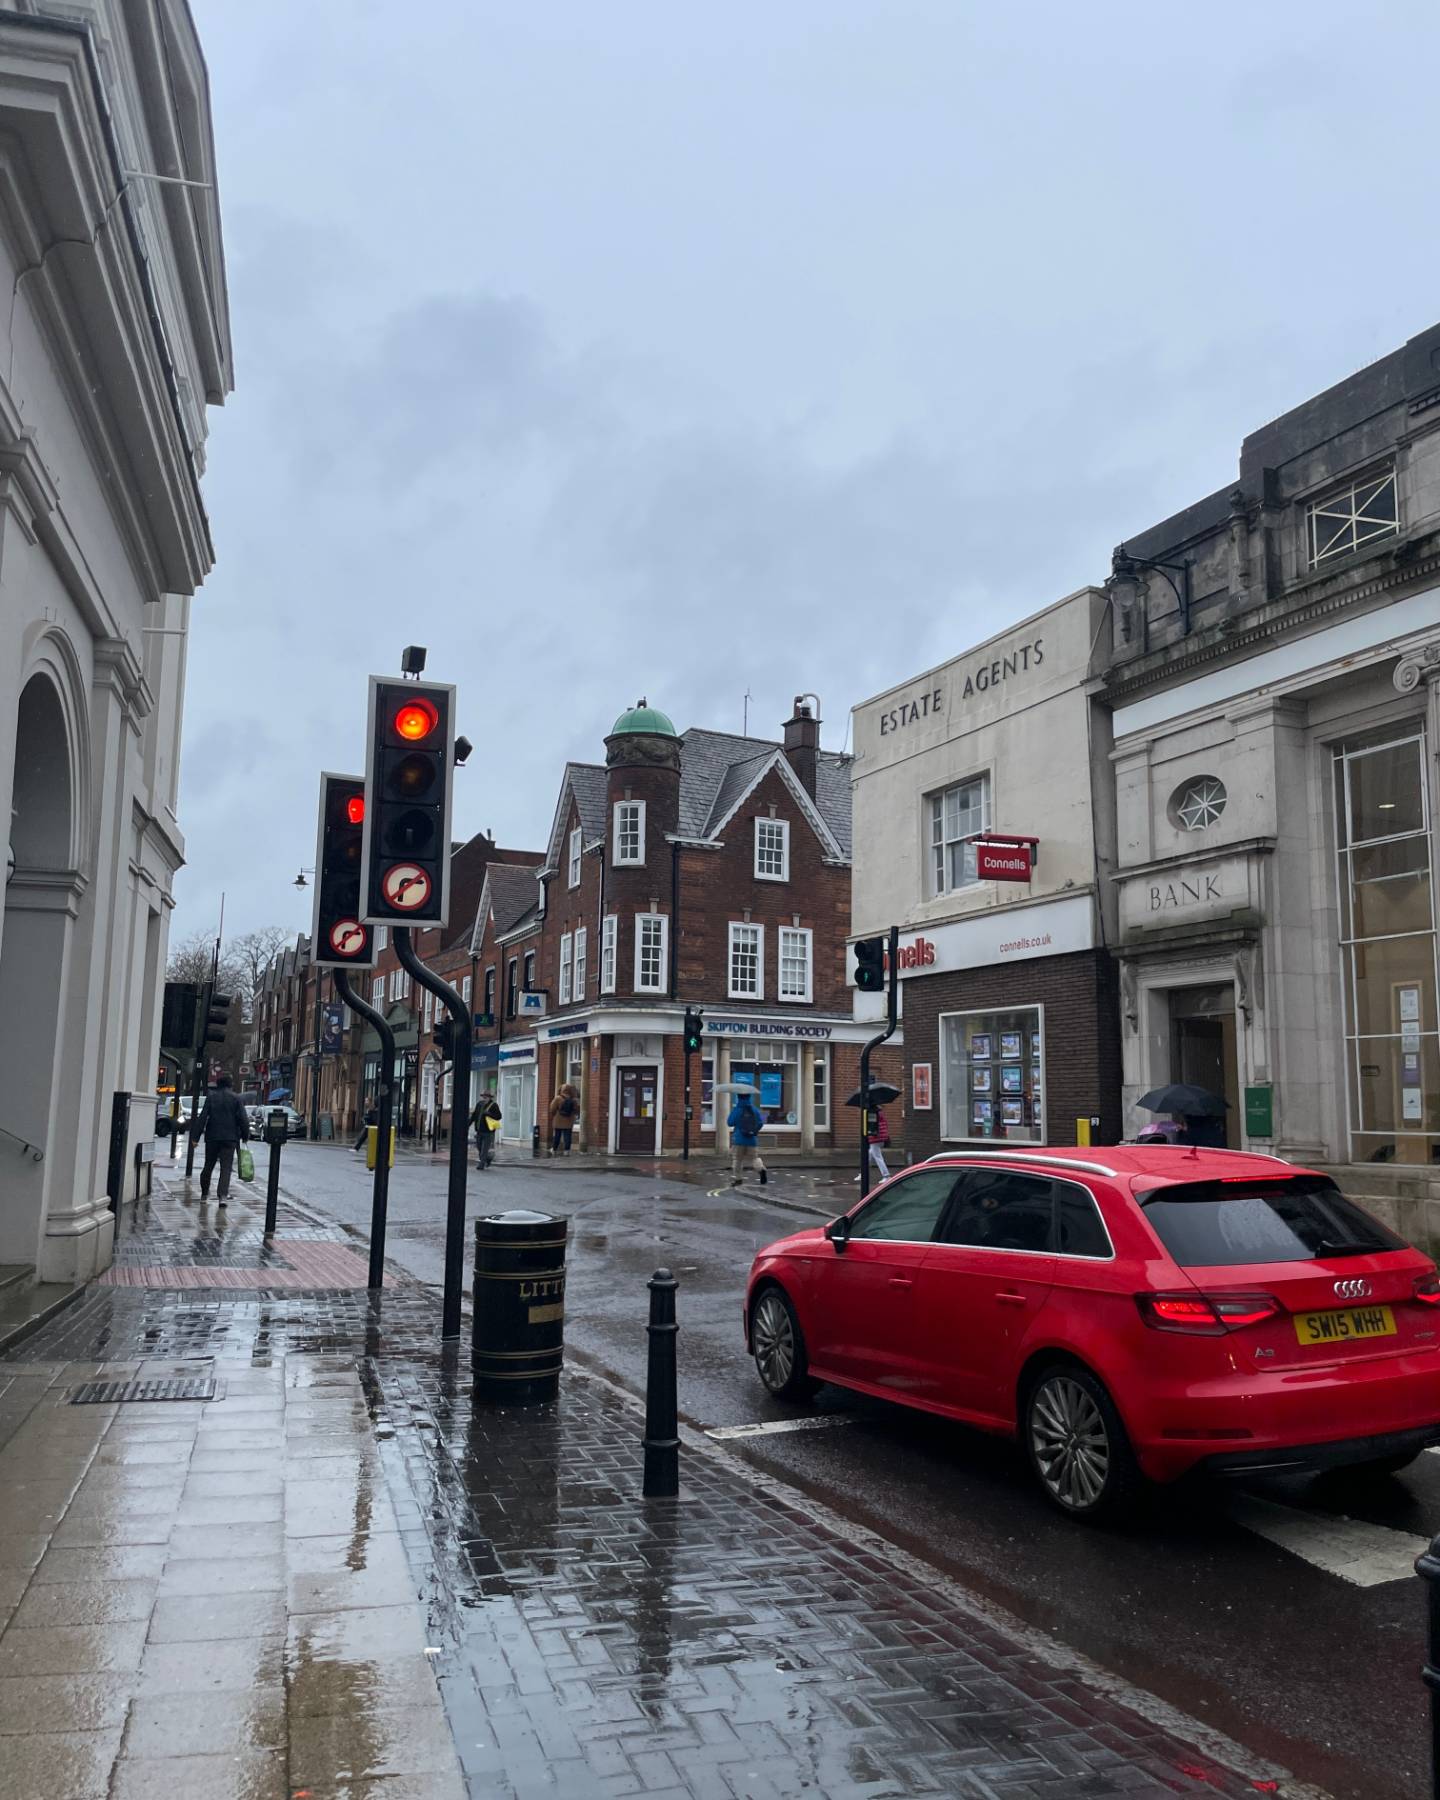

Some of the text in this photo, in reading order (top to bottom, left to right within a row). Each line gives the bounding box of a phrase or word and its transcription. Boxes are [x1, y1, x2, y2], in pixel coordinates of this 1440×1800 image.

[880, 639, 1044, 736] ESTATE AGENTS
[983, 856, 1027, 871] Connells
[1150, 874, 1222, 912] BANK
[882, 937, 936, 971] nells
[999, 933, 1053, 953] connells.co.uk
[707, 1021, 833, 1039] SKIPTON BUILDING SOCIETY
[1306, 1309, 1388, 1339] SW15 WHH
